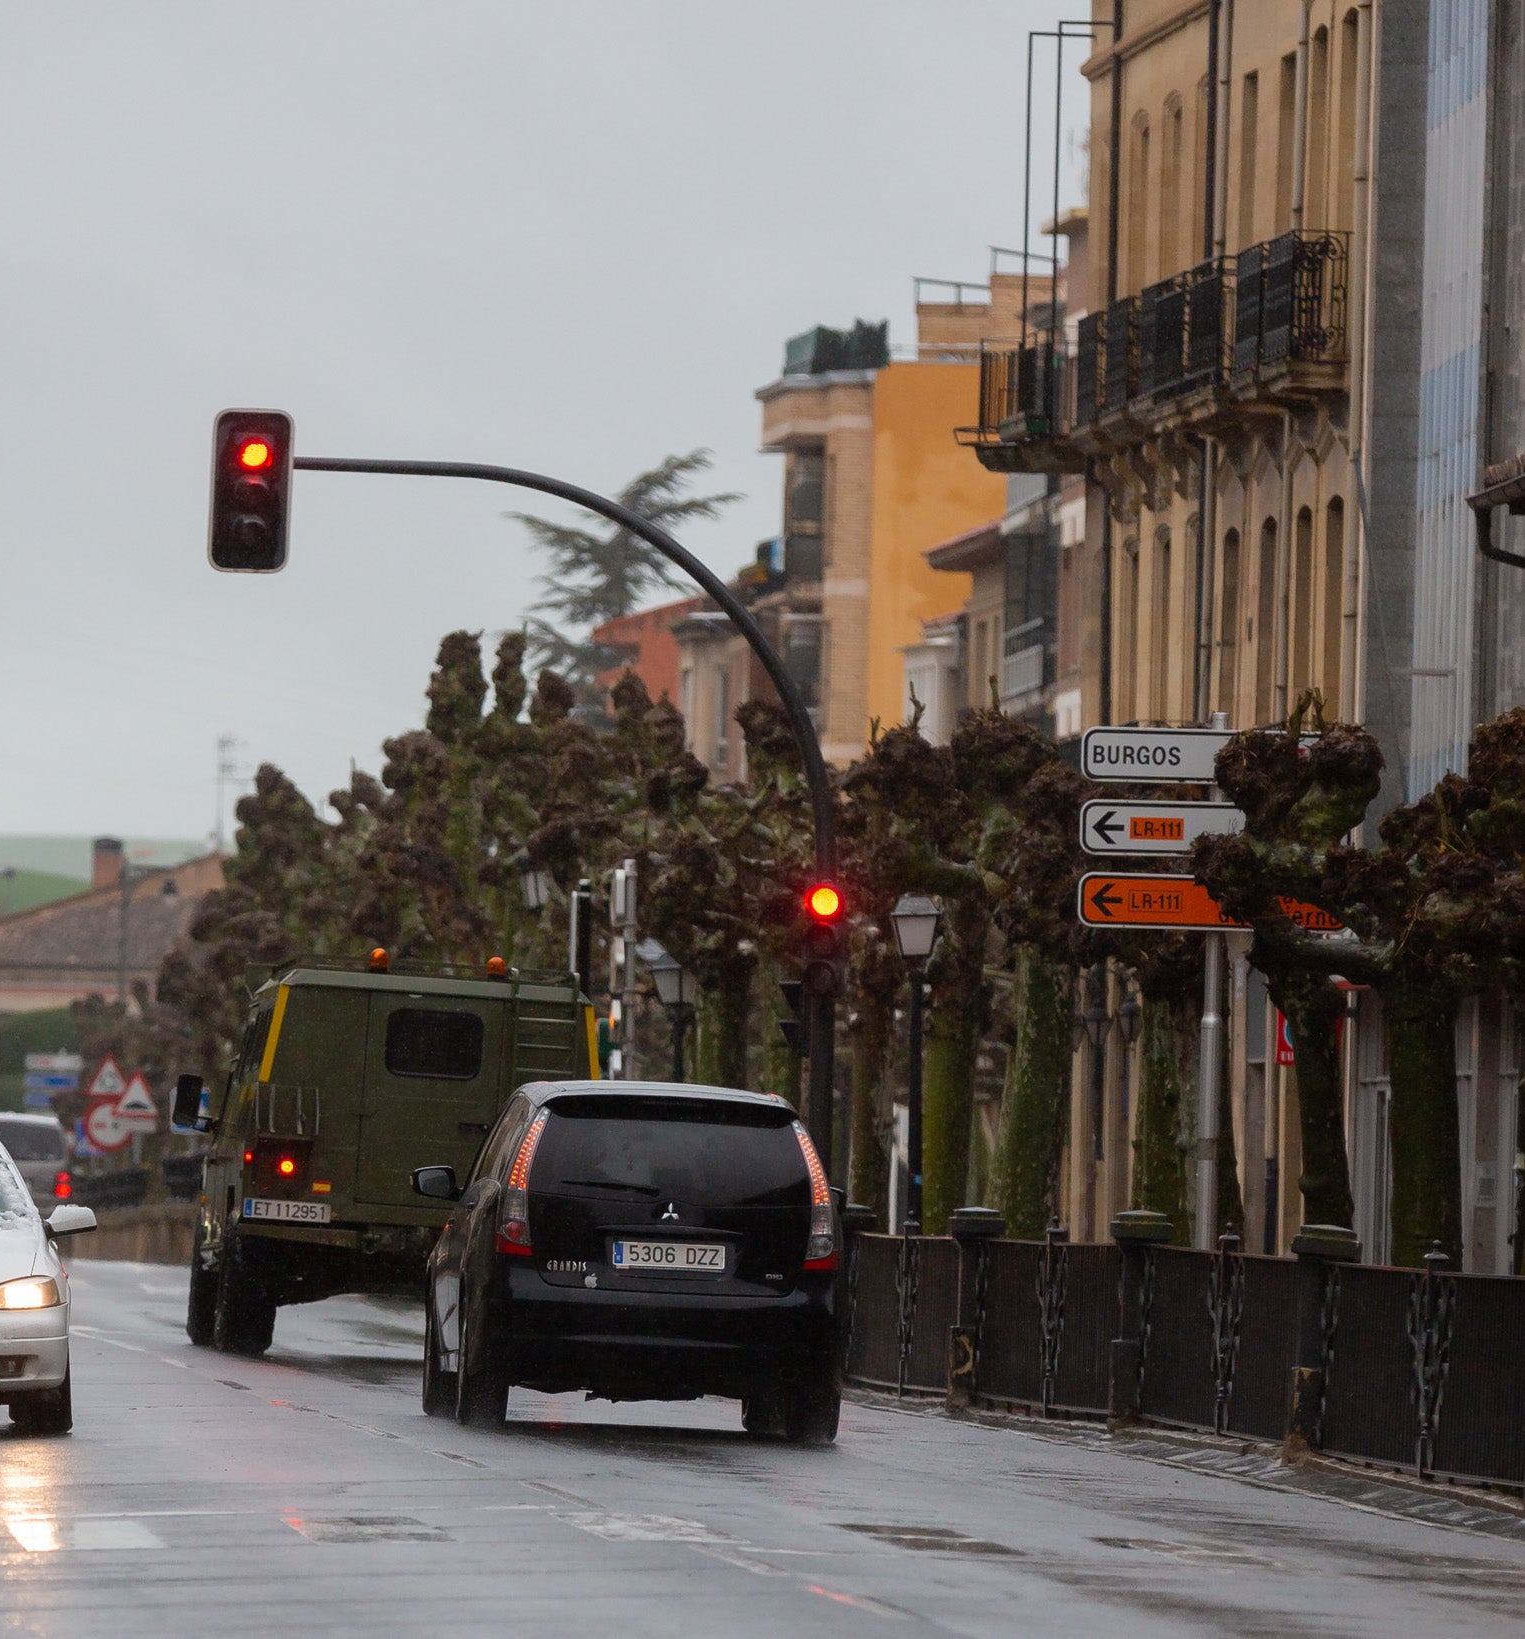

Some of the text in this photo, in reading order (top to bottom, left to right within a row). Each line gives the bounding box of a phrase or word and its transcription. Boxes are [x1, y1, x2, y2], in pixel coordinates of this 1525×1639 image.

[1092, 744, 1182, 767] BURGOS
[1133, 820, 1184, 838] LR-111
[1130, 892, 1181, 911] LR-111
[629, 1244, 720, 1267] 5306 DZZ
[546, 1259, 587, 1273] GRANDIS
